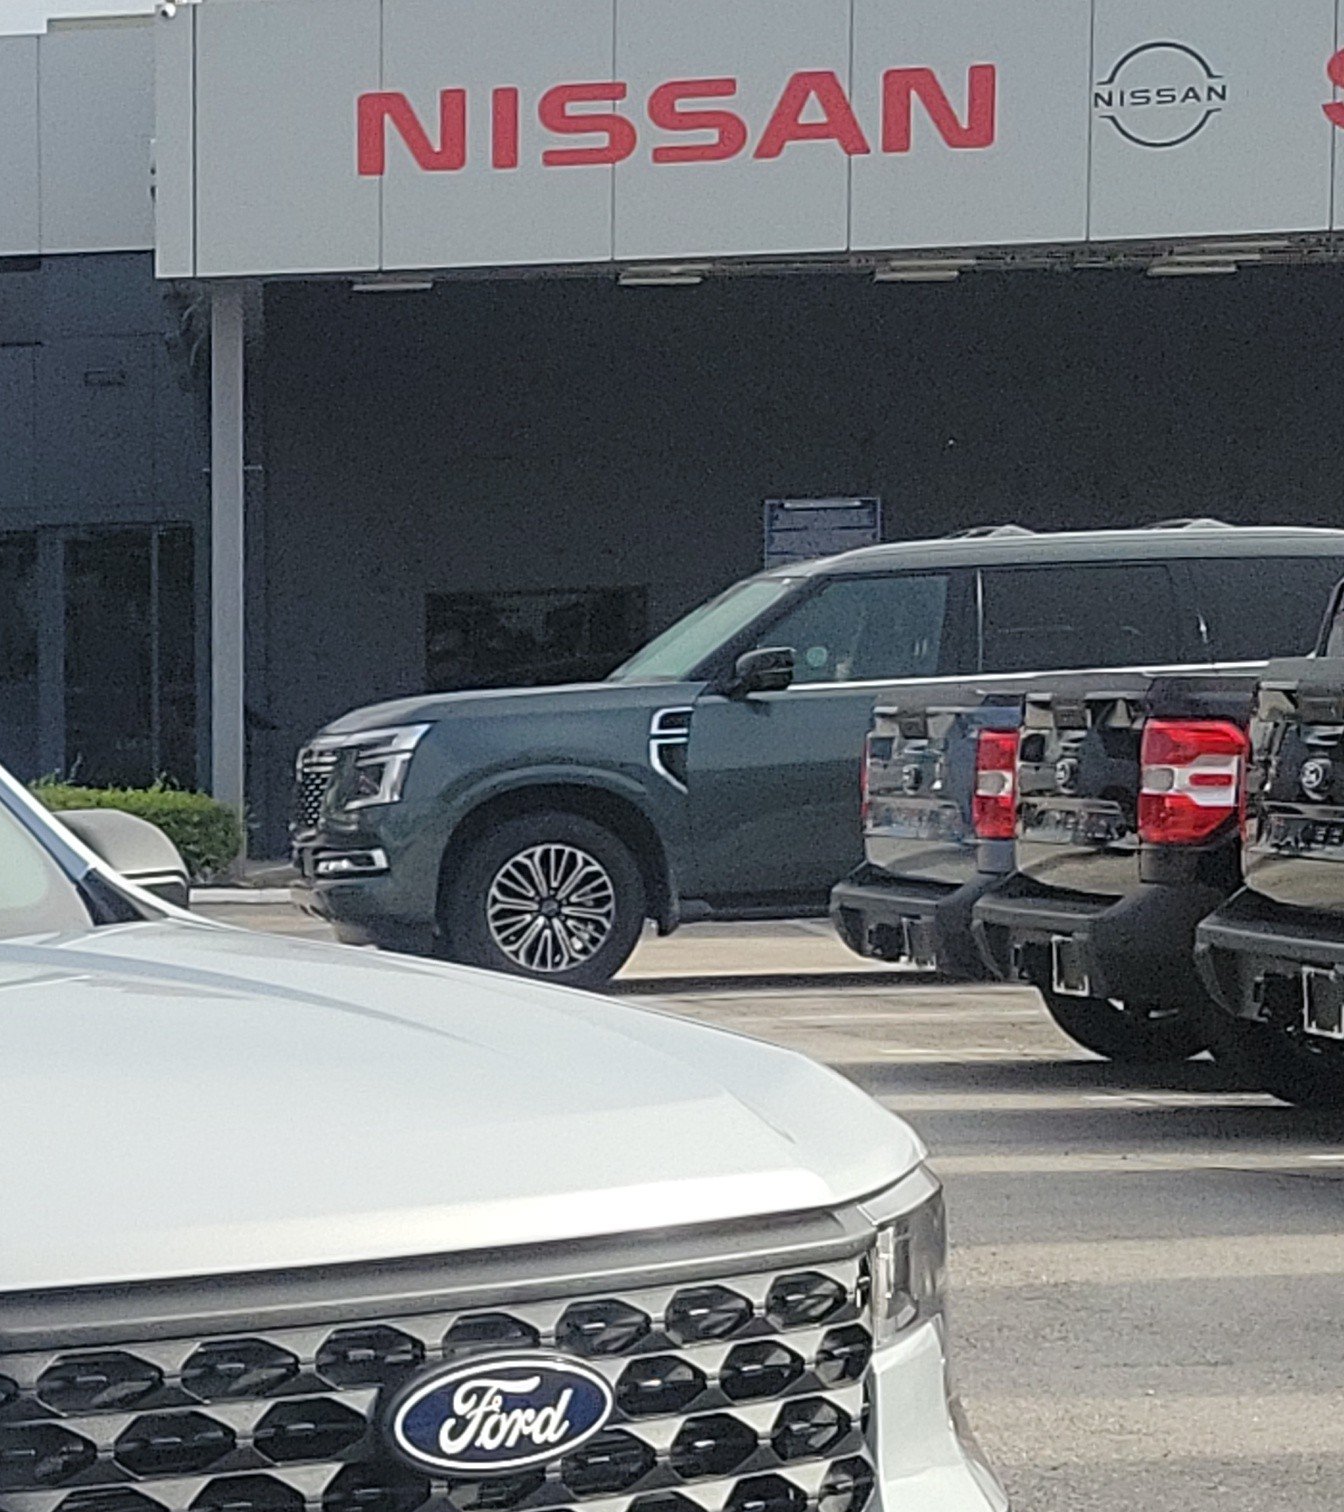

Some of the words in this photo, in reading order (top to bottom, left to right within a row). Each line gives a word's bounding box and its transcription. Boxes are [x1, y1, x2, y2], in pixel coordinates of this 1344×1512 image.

[356, 64, 996, 176] NISSAN
[1094, 85, 1226, 108] NISSAN
[439, 1375, 573, 1454] Ford
